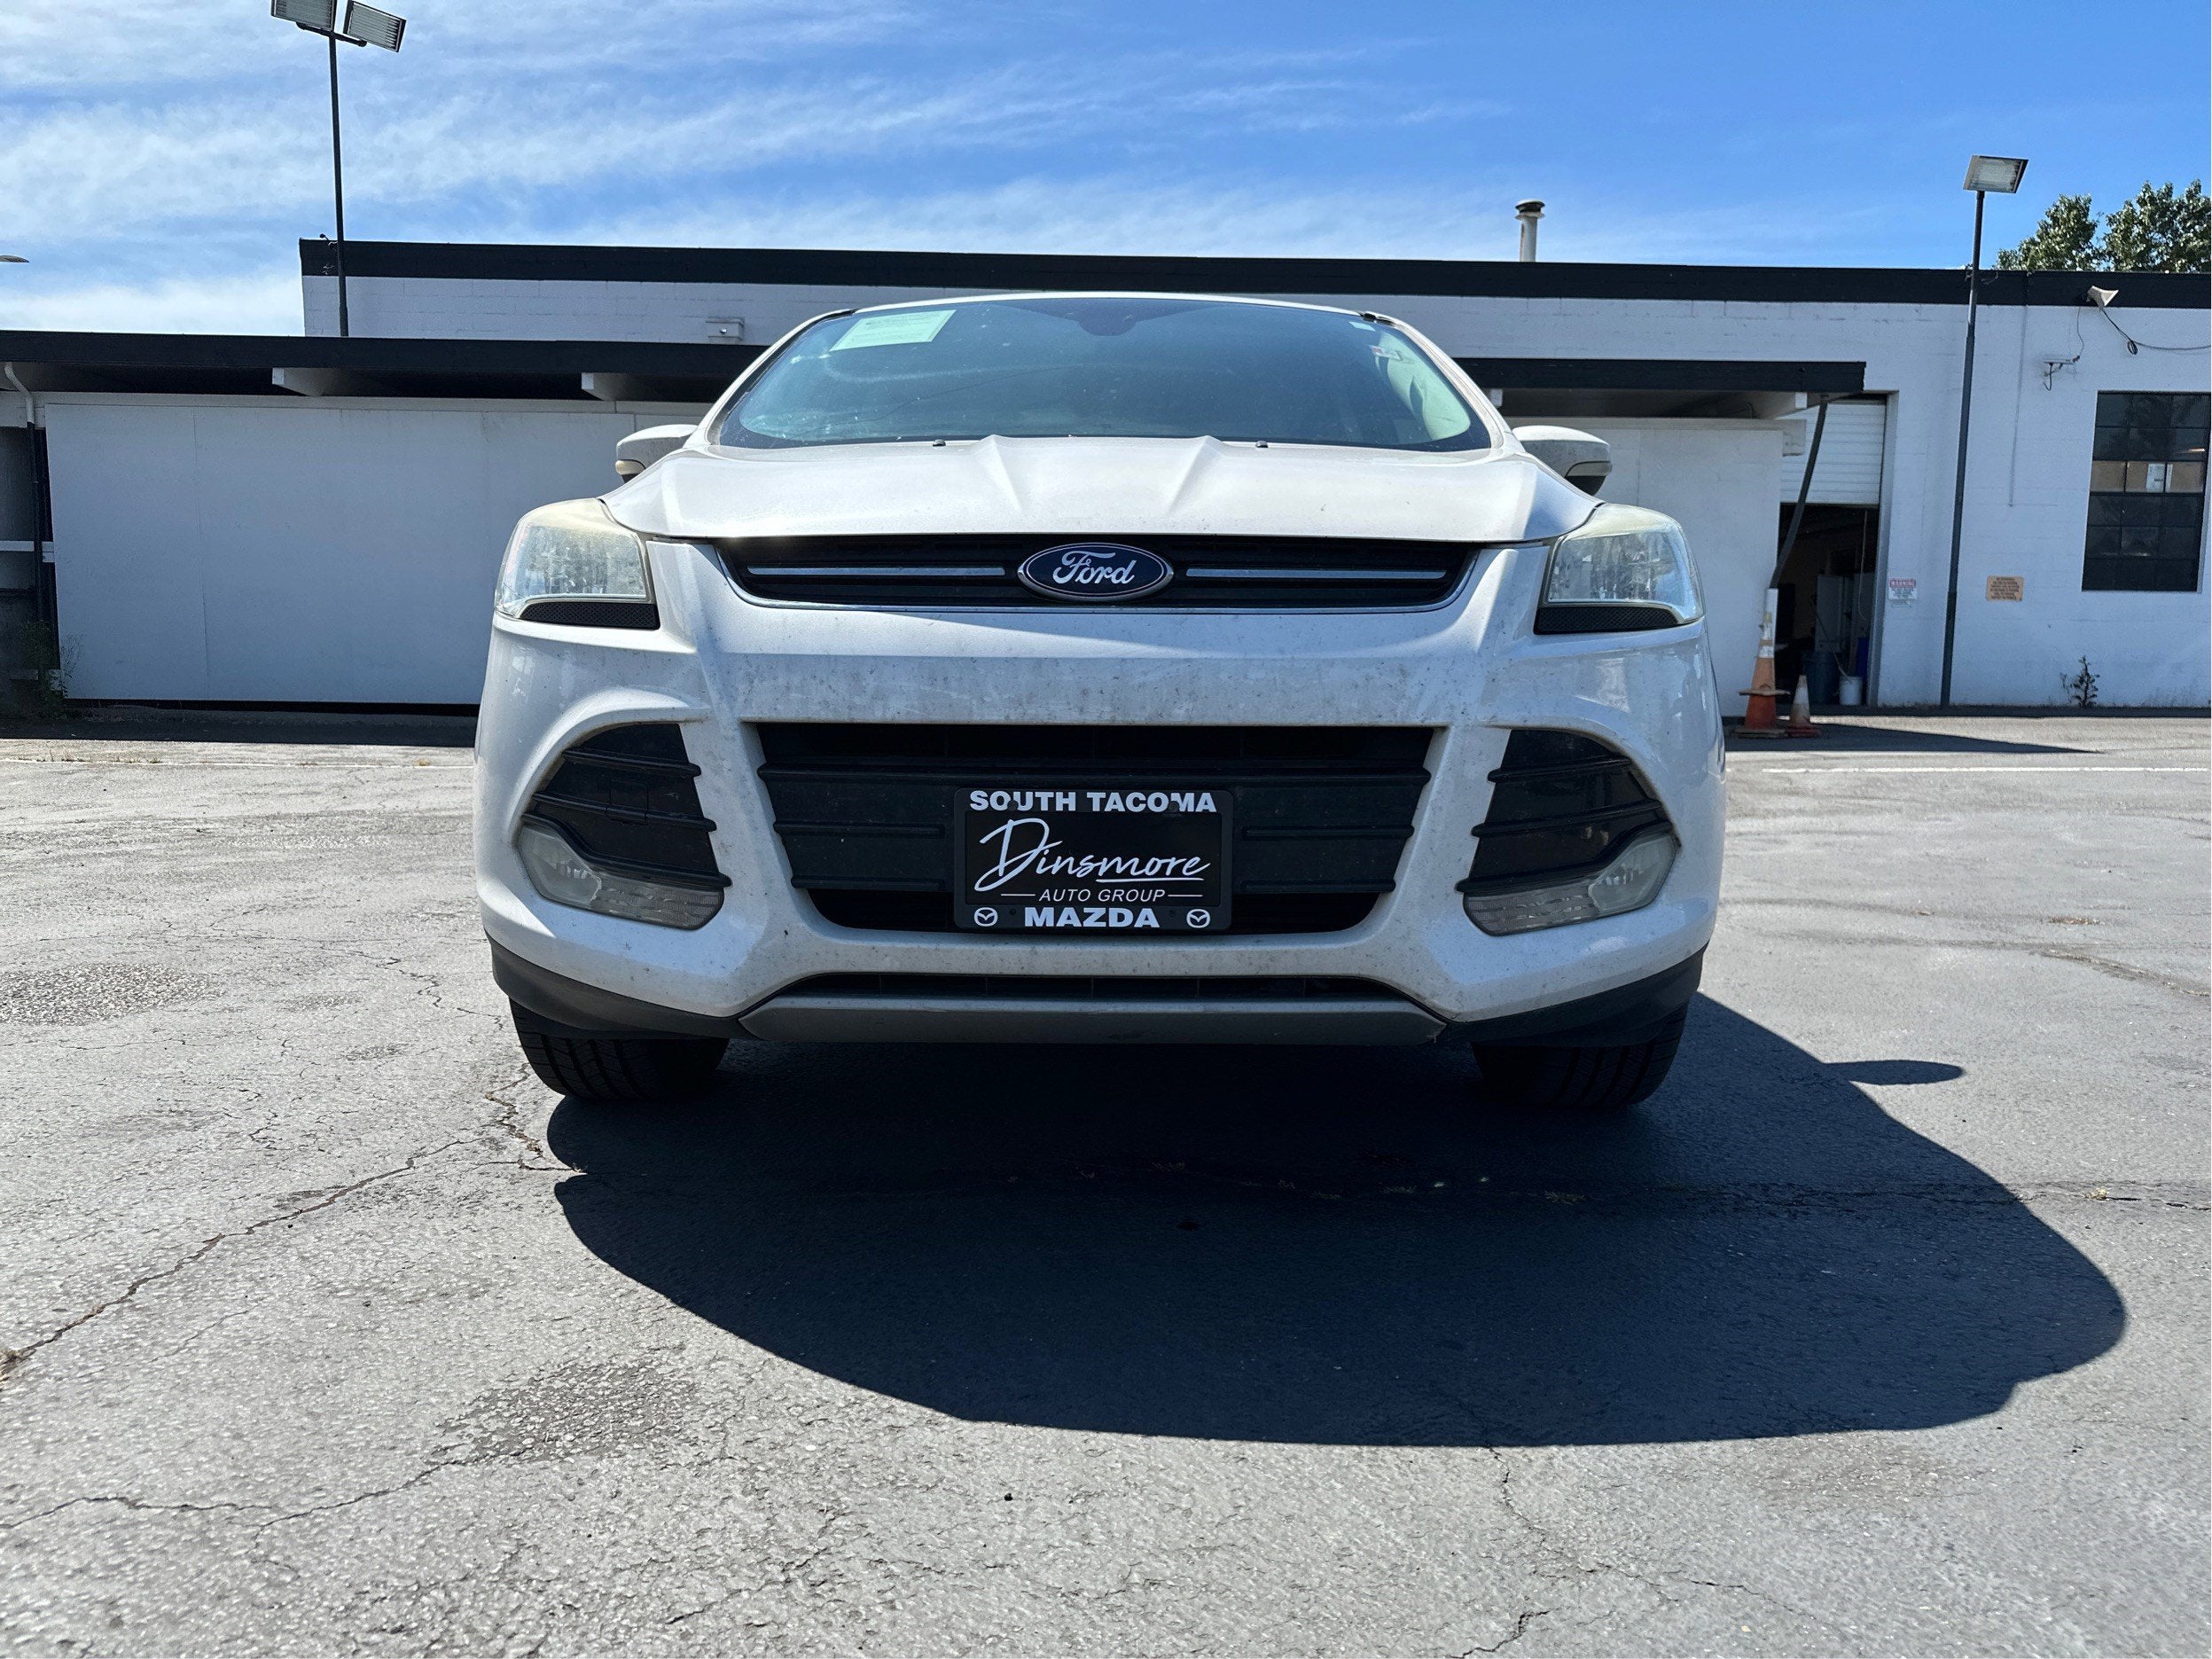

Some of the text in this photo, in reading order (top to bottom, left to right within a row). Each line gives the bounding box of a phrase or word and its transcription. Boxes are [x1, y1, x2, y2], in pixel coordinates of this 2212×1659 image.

[1052, 551, 1137, 584] Ford
[969, 790, 1217, 812] SOUTH TACOMA
[974, 818, 1211, 892] Dinsmore
[1038, 888, 1166, 902] AUTO GROUP
[1024, 907, 1161, 927] MAZDA
